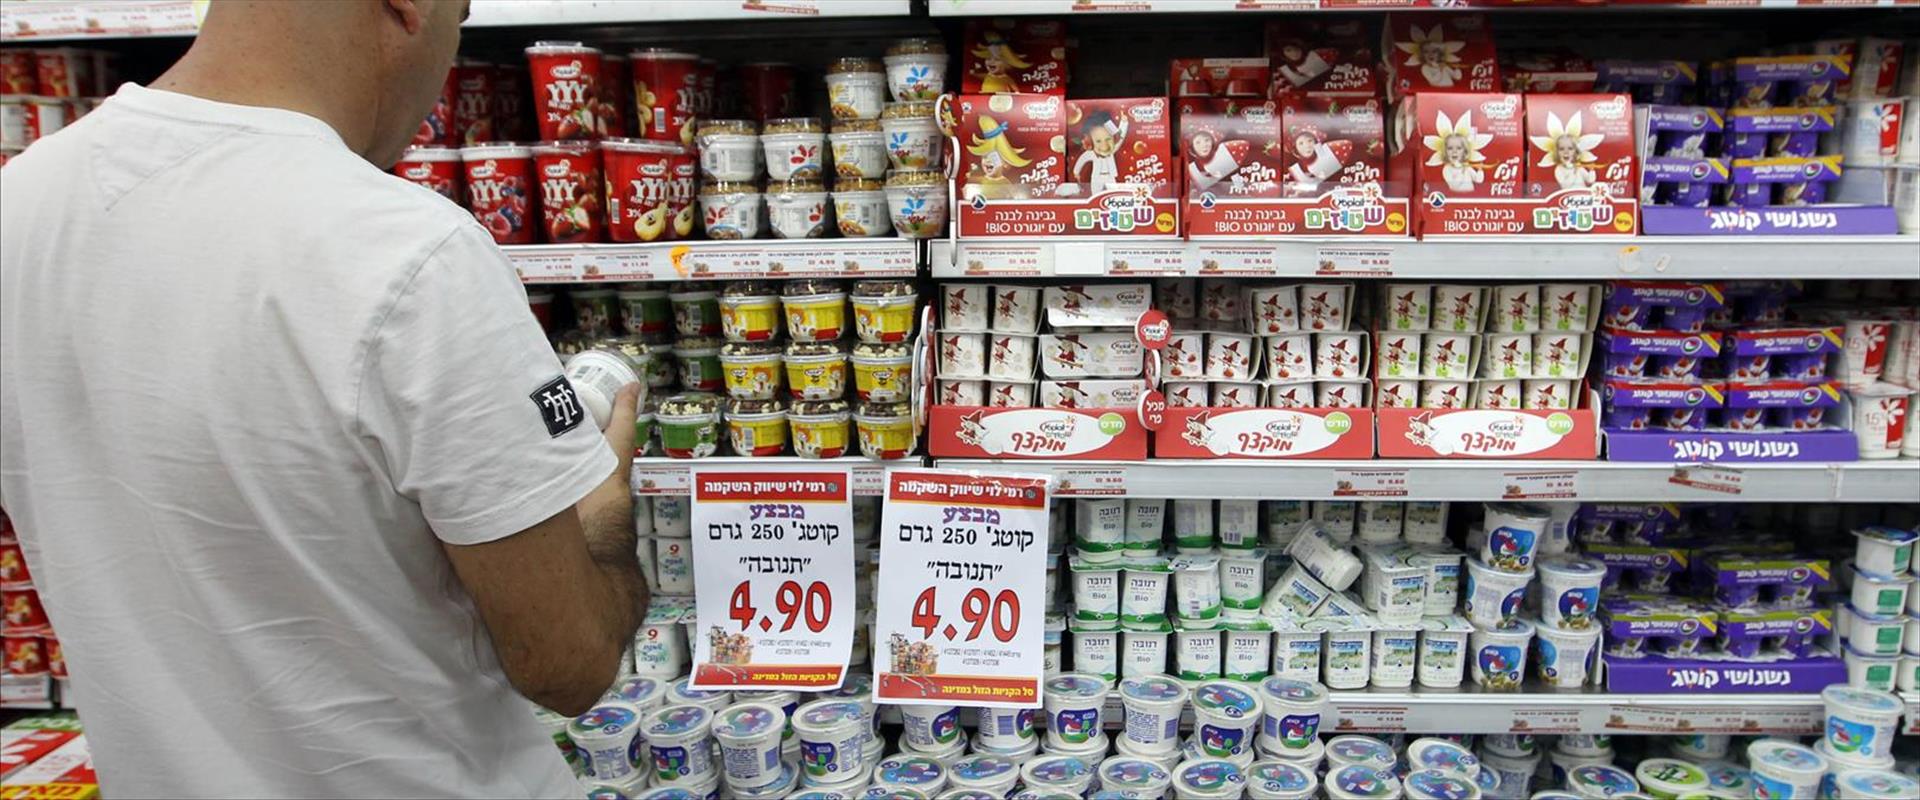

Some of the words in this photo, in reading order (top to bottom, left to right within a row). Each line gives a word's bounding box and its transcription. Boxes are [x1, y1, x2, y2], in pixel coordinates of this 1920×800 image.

[1107, 198, 1134, 208] Yoplait
[1338, 197, 1364, 207] Yoplait
[1566, 197, 1593, 207] Yoplait
[994, 207, 1023, 221] לבנה
[1026, 210, 1056, 221] גבינה
[1224, 207, 1252, 221] לבנה
[1255, 209, 1286, 221] גבינה
[1454, 206, 1482, 220] לבנה
[1484, 209, 1515, 220] גבינה
[1764, 211, 1838, 229] נשנושי
[1013, 223, 1045, 234] יוגורט
[1048, 224, 1066, 235] עם
[1243, 222, 1276, 234] יוגורט
[1278, 222, 1296, 234] עם
[1472, 221, 1504, 233] יוגורט
[1506, 221, 1525, 234] עם
[1011, 432, 1066, 452] מוקצף
[1237, 432, 1293, 452] מוקצף
[1461, 432, 1517, 452] מוקצף
[1727, 441, 1800, 459] נשנושי
[704, 482, 751, 495] השקמה
[753, 482, 787, 495] שיווק
[788, 480, 804, 493] לוי
[805, 482, 826, 493] רמי
[898, 481, 948, 496] השקמה
[950, 484, 984, 498] שיווק
[985, 482, 1002, 498] לוי
[1004, 487, 1025, 498] רמי
[749, 504, 805, 521] מבצע
[942, 507, 1001, 525] מבצע
[708, 523, 743, 540] גרם
[751, 523, 784, 540] 250
[792, 521, 840, 546] קוטג'
[899, 524, 933, 543] גרם
[942, 527, 978, 545] 250
[986, 526, 1035, 553] קוטג'
[669, 544, 679, 555] 9
[729, 580, 833, 633] 4.90
[911, 586, 1021, 642] 4.90
[648, 629, 658, 641] 9
[1723, 669, 1792, 686] נשנושי
[942, 685, 972, 695] במדינה
[972, 684, 991, 695] הזול
[994, 687, 1021, 698] הקניות
[1022, 686, 1035, 698] סל
